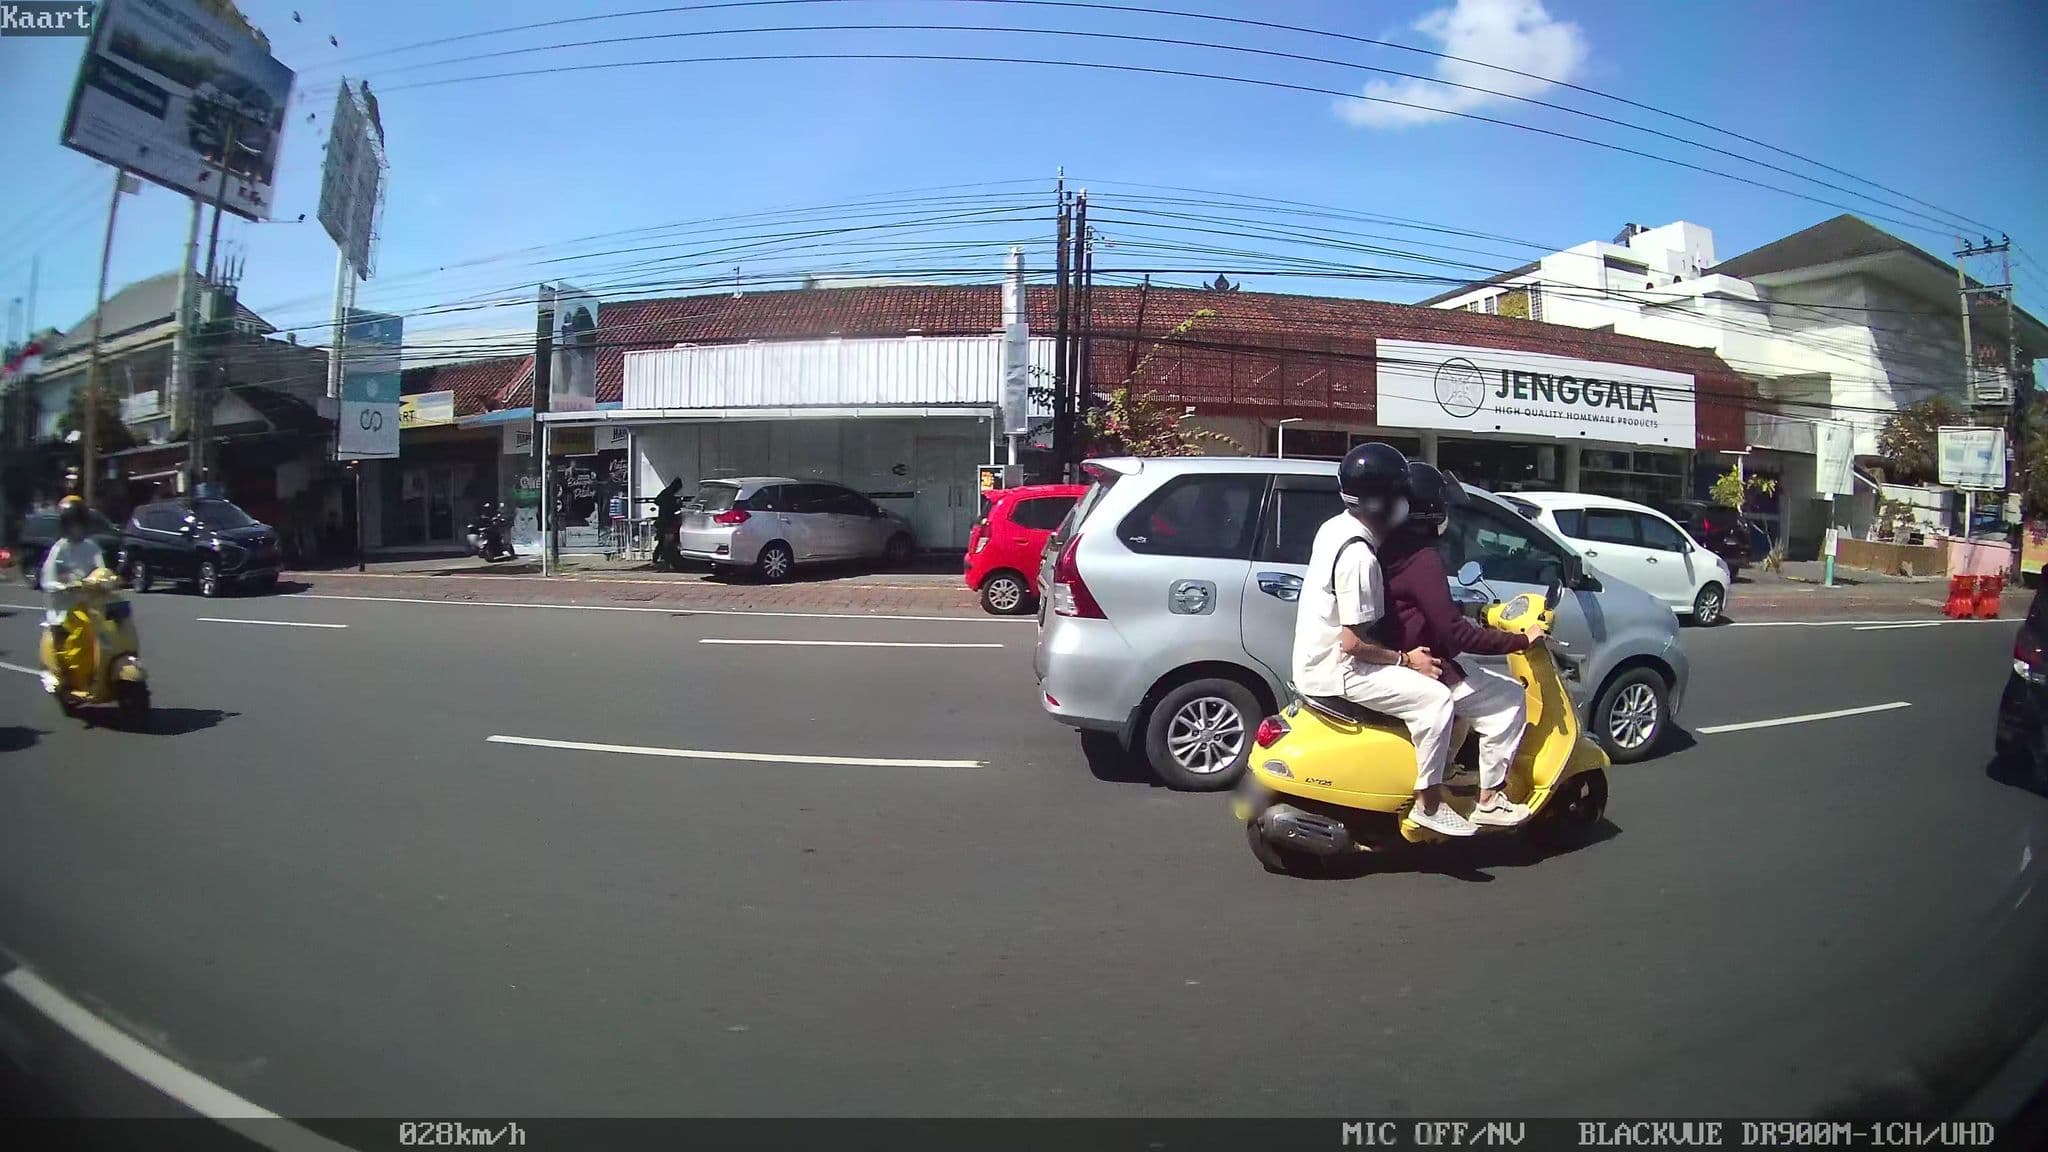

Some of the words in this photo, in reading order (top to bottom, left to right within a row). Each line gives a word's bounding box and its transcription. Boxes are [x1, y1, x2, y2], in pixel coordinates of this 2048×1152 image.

[1495, 369, 1658, 413] JENGGALA
[1495, 406, 1520, 414] HIGH
[1524, 407, 1563, 419] QUALITY
[1566, 412, 1615, 424] HOMEWARE
[1617, 416, 1658, 428] PRODUCTS
